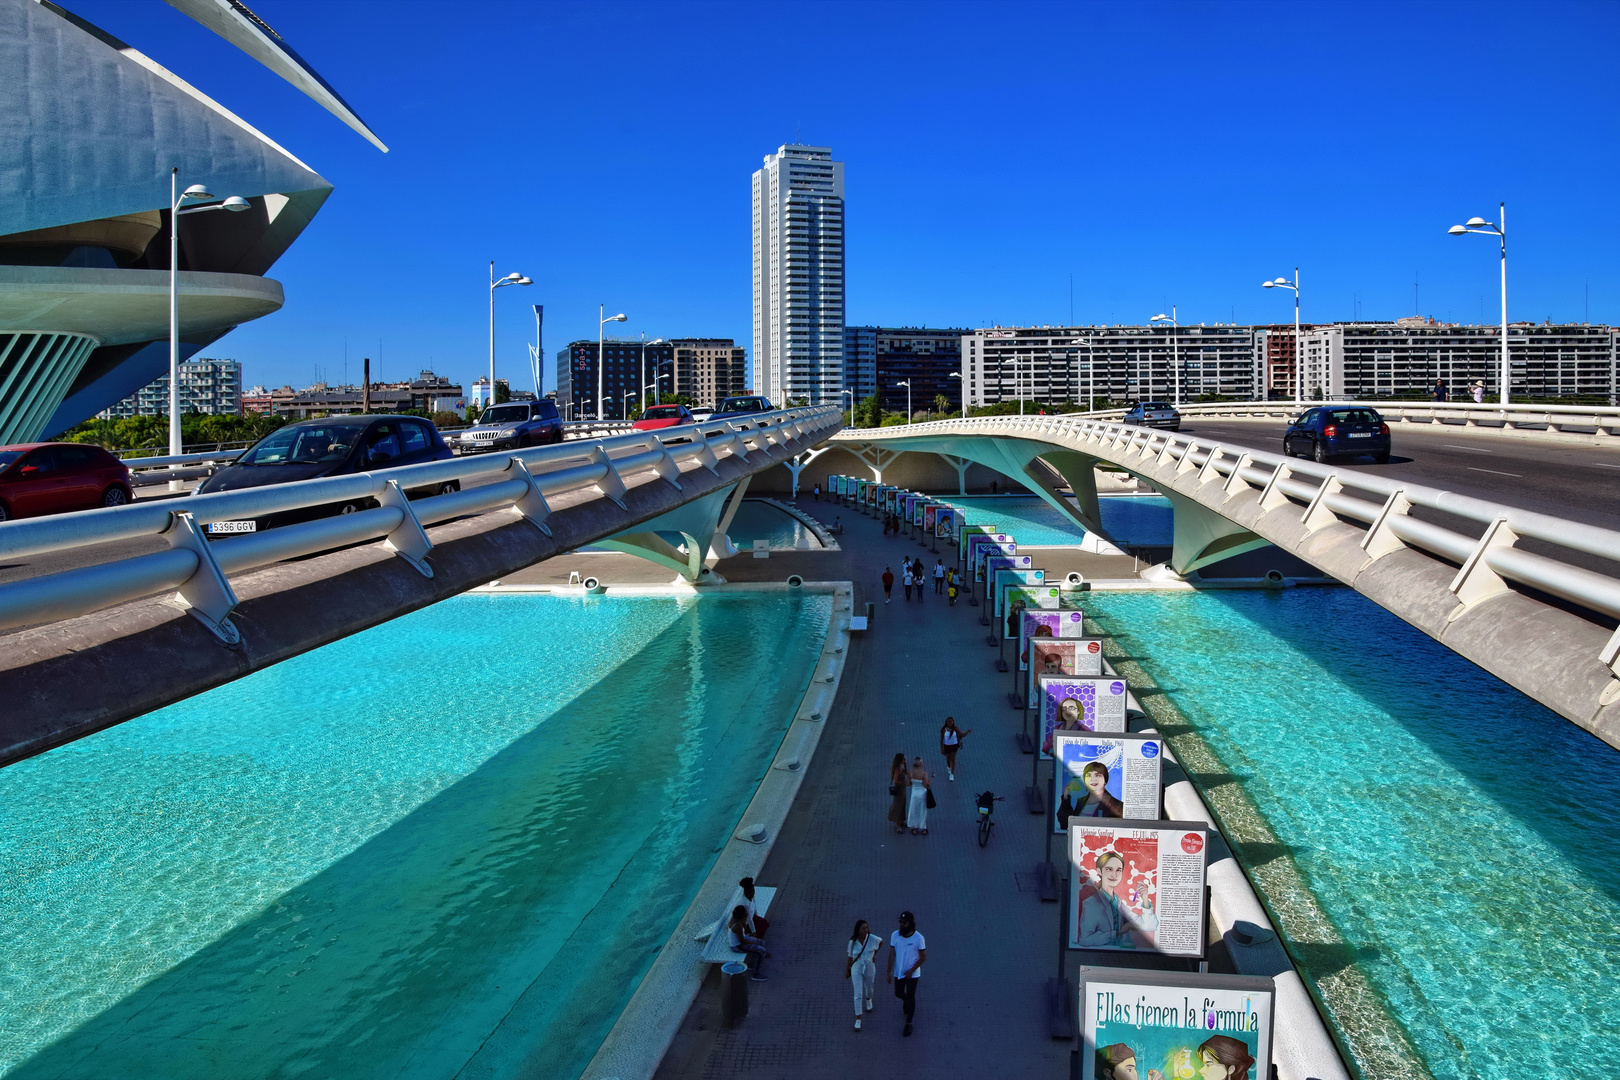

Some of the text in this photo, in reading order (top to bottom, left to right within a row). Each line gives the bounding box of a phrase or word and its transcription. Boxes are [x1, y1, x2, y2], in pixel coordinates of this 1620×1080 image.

[213, 522, 254, 531] 5396 GGV
[1096, 992, 1259, 1032] Ellas tienen la fórmula
